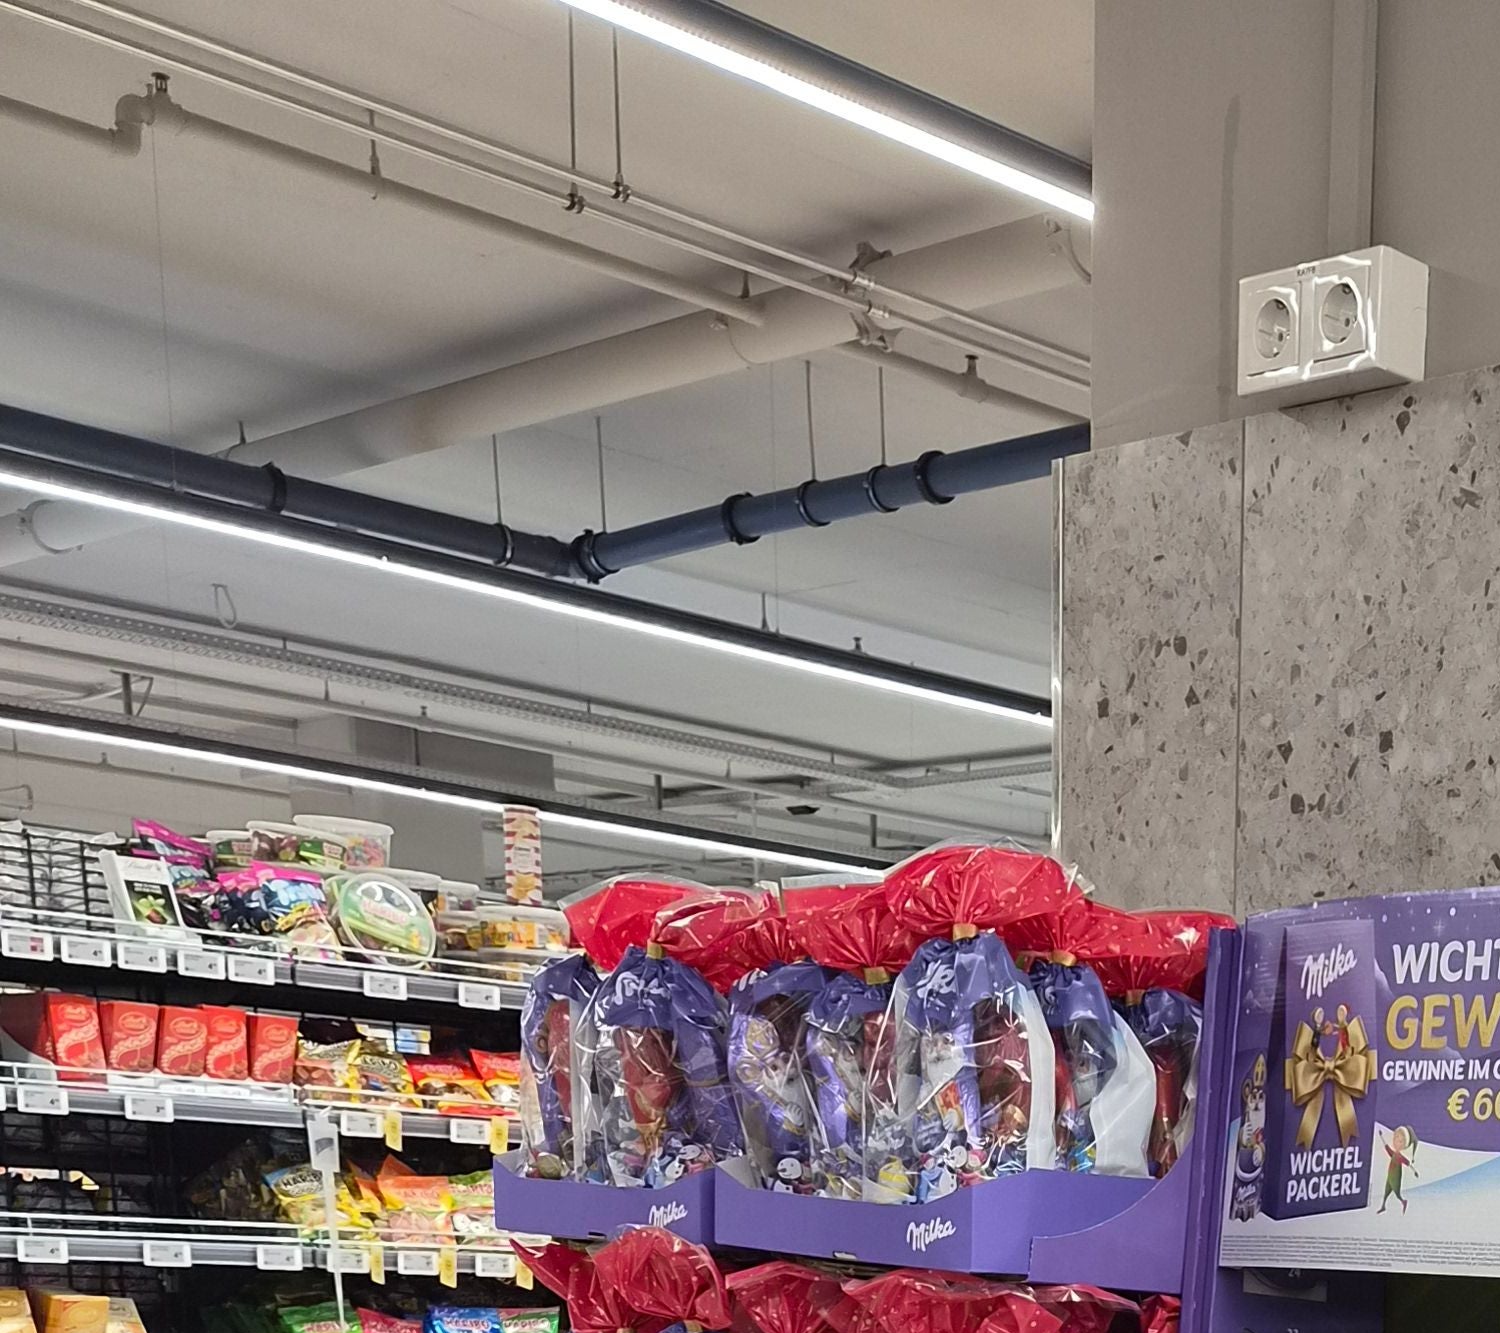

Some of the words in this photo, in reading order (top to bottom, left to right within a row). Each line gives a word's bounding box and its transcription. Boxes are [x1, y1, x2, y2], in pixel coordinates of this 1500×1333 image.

[1301, 943, 1357, 999] Milka
[1382, 1059, 1465, 1081] GEWINNE
[1468, 1059, 1491, 1080] IM
[1290, 1146, 1363, 1176] WICHTEL
[1286, 1175, 1361, 1203] PACKERL
[648, 1201, 689, 1230] Milka
[906, 1214, 957, 1252] Milka
